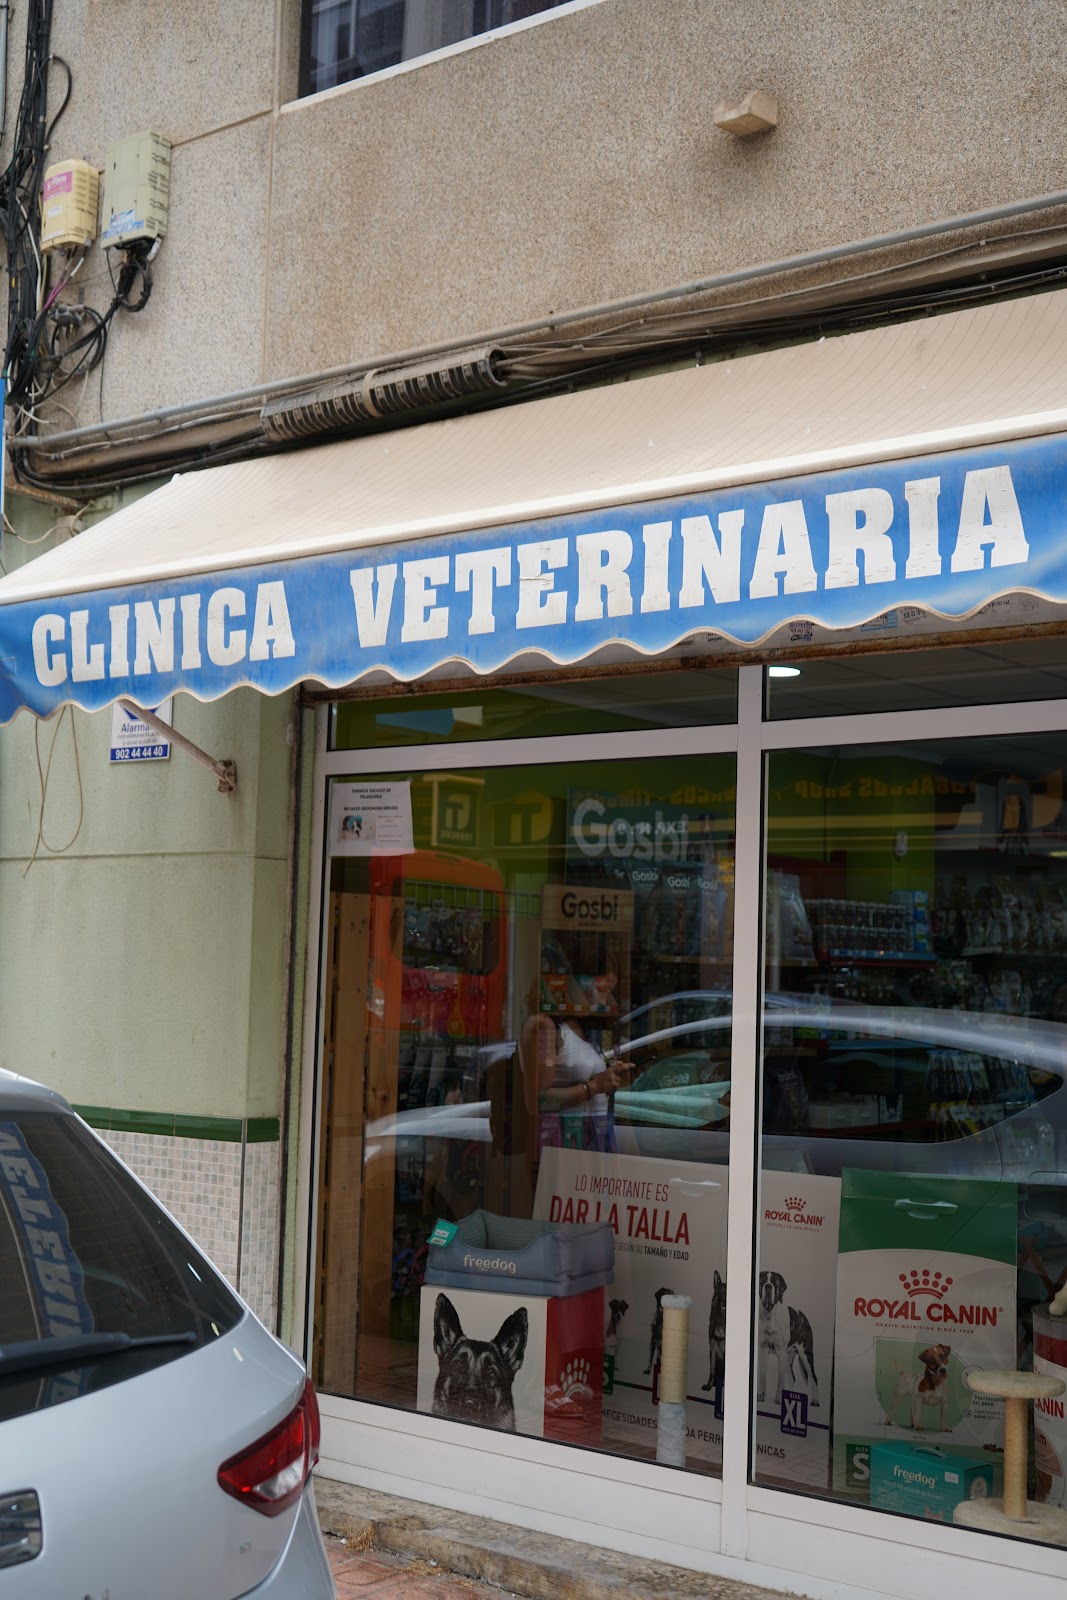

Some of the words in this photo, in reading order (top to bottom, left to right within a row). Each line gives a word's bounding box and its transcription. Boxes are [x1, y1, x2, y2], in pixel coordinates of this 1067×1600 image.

[32, 579, 296, 688] CLINICA
[349, 464, 1031, 648] VETERINARIA
[115, 748, 130, 760] 902
[131, 747, 141, 758] 44
[142, 746, 152, 757] 44
[153, 745, 163, 756] 40
[573, 798, 689, 863] Gosbi
[560, 892, 618, 921] Gosbi
[575, 1174, 588, 1192] LO
[589, 1175, 653, 1200] IMPORTANTE
[655, 1183, 670, 1202] ES
[549, 1195, 590, 1224] DAR
[626, 1205, 690, 1246] TALLA
[764, 1209, 792, 1222] ROYAL
[463, 1254, 517, 1276] freedog
[635, 1243, 643, 1253] SU
[643, 1244, 668, 1258] TAMAÑO
[668, 1249, 673, 1258] Y
[673, 1249, 690, 1261] EDAD
[854, 1297, 922, 1321] ROYAL
[782, 1398, 806, 1430] XL
[1034, 1397, 1065, 1419] ANIN
[602, 1408, 658, 1429] NECESIDADES
[757, 1443, 786, 1459] NICAS
[852, 1452, 870, 1481] S
[893, 1464, 936, 1489] freedog
